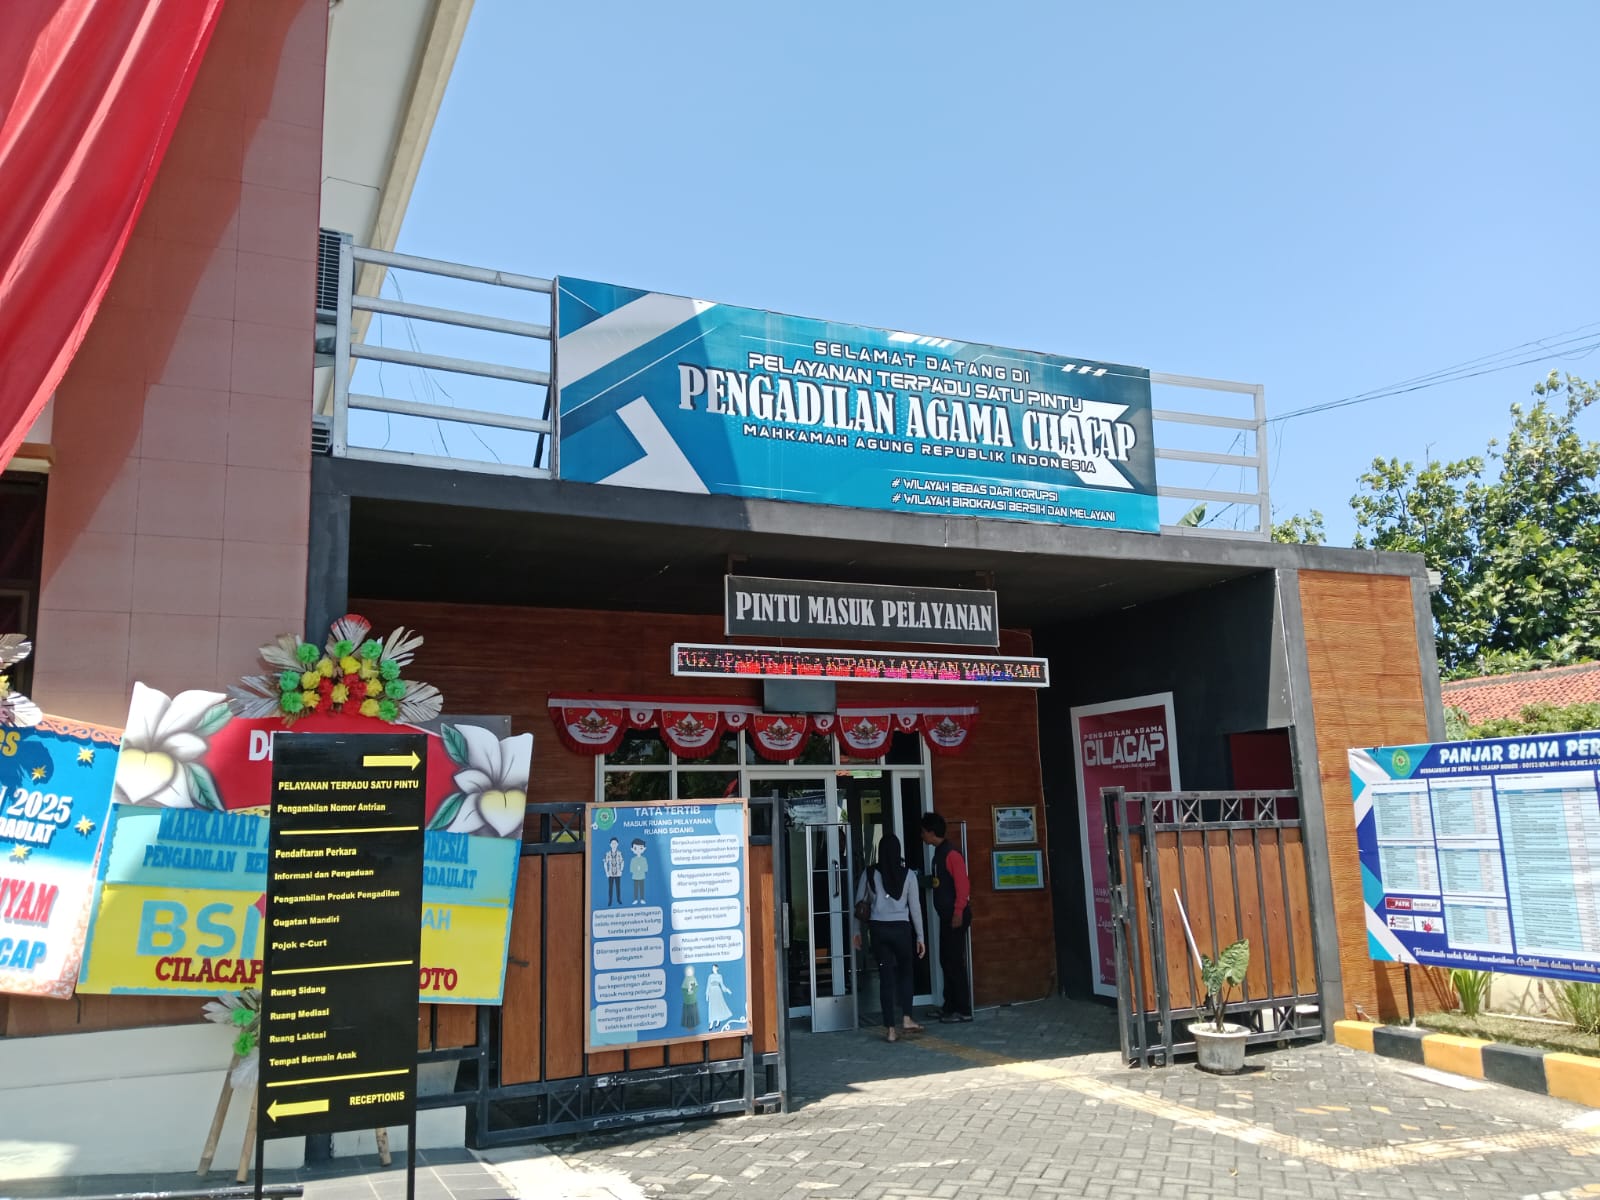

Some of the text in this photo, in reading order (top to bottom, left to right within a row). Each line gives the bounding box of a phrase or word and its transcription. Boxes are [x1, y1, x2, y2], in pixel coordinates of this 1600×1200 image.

[814, 341, 1031, 384] SELAMAT DATANG DI
[748, 352, 1084, 412] PELAYANAN TERPADU SATU PINTU
[677, 362, 1137, 462] PENGADILAN AGAMA CILACAP
[742, 424, 1097, 474] MAHKAMAH AGUNG REPUBLIK INDONESIA
[903, 479, 950, 494] WILAYAH
[951, 482, 987, 497] BEBAS
[988, 486, 1013, 499] DARI
[1014, 489, 1059, 503] KORUPSI
[903, 494, 951, 508] WILAYAH
[952, 497, 1007, 512] BIROKRASI
[1008, 501, 1045, 515] BERSIH
[1046, 504, 1067, 517] DAN
[1069, 508, 1116, 522] MELAYANI
[735, 591, 992, 632] PINTU MASUK PELAYANAN
[961, 661, 1001, 677] YANG
[1004, 663, 1041, 679] KAMI
[1083, 725, 1164, 740] PENGADILAN AGAMA
[1083, 733, 1165, 766] CILACAP
[1439, 744, 1504, 764] PANJAR
[1508, 740, 1560, 760] BIAYA
[278, 780, 419, 791] PELAYANAN TERPADU SATU PINTU
[6, 787, 73, 823] 2025
[277, 802, 386, 815] Pengambilan Nomor Antrian
[634, 806, 701, 817] TATA TERTIB
[157, 808, 260, 847] MAHKAMAH
[623, 820, 647, 828] MASUK
[648, 819, 672, 827] RUANG
[644, 827, 668, 835] RUANG
[143, 845, 236, 873] PENGADILAN
[275, 847, 357, 859] Pendaftaran Perkara
[274, 869, 374, 880] Informasi dan Pengaduan
[273, 890, 400, 904] Pengambilan Produk Pengadilan
[136, 899, 261, 959] BSI
[273, 915, 340, 928] Gugatan Mandiri
[272, 939, 327, 951] Pojok e-Curt
[155, 956, 264, 983] CILACAP
[270, 985, 326, 997] Ruang Sidang
[270, 1008, 330, 1021] Ruang Mediasi
[269, 1031, 327, 1044] Ruang Laktasi
[269, 1051, 357, 1067] Tempat Bermain Anak
[349, 1091, 405, 1106] RECEPTIONIS
